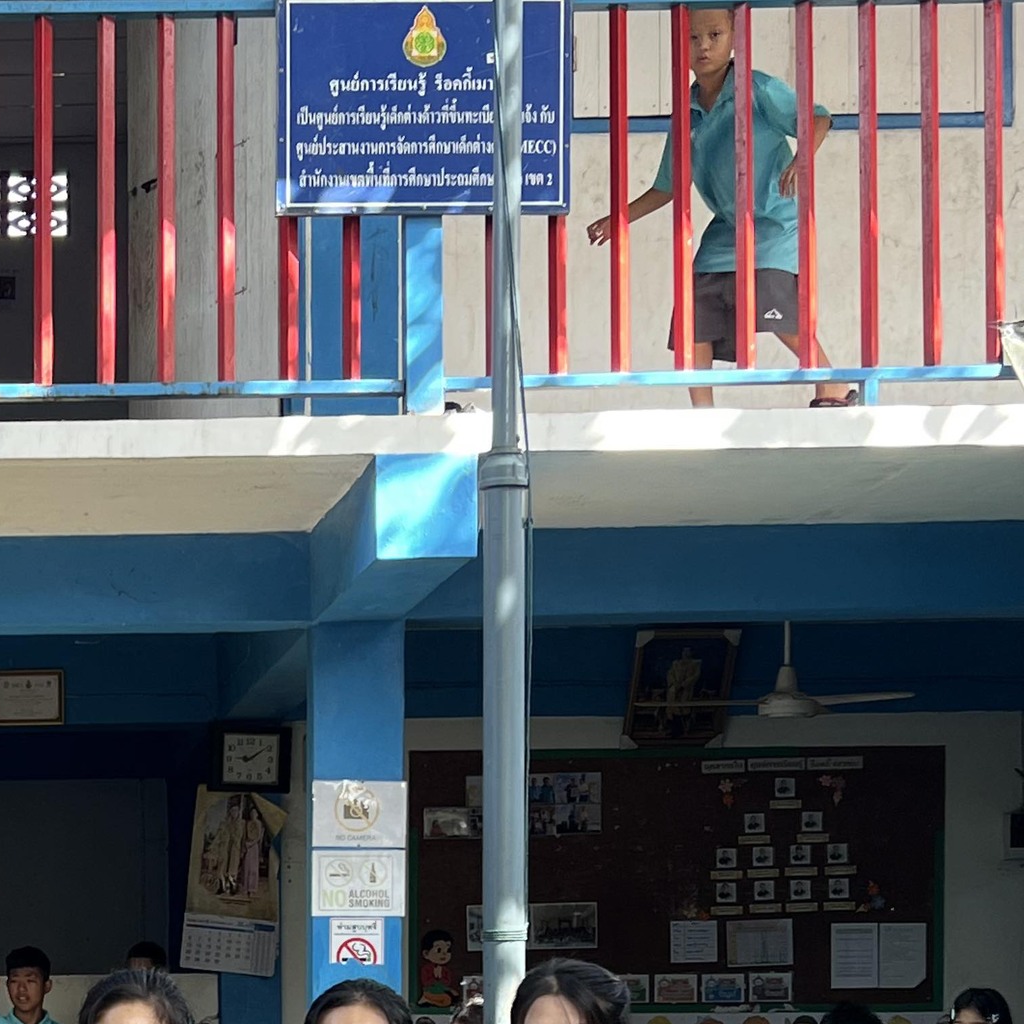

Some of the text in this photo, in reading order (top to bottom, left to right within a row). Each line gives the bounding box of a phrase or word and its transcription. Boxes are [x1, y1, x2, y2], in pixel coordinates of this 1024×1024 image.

[329, 66, 494, 97] ศูนย์การเรียนรู้ ร็อคกี้เมา
[541, 104, 555, 124] กับ
[296, 134, 495, 162] ศูนย์ประสานงานการจัดการศึกษาเด็กต่าง
[546, 172, 554, 187] 2
[322, 889, 346, 908] NO
[348, 888, 390, 899] ALCOHOL
[348, 898, 390, 908] SMOKING
